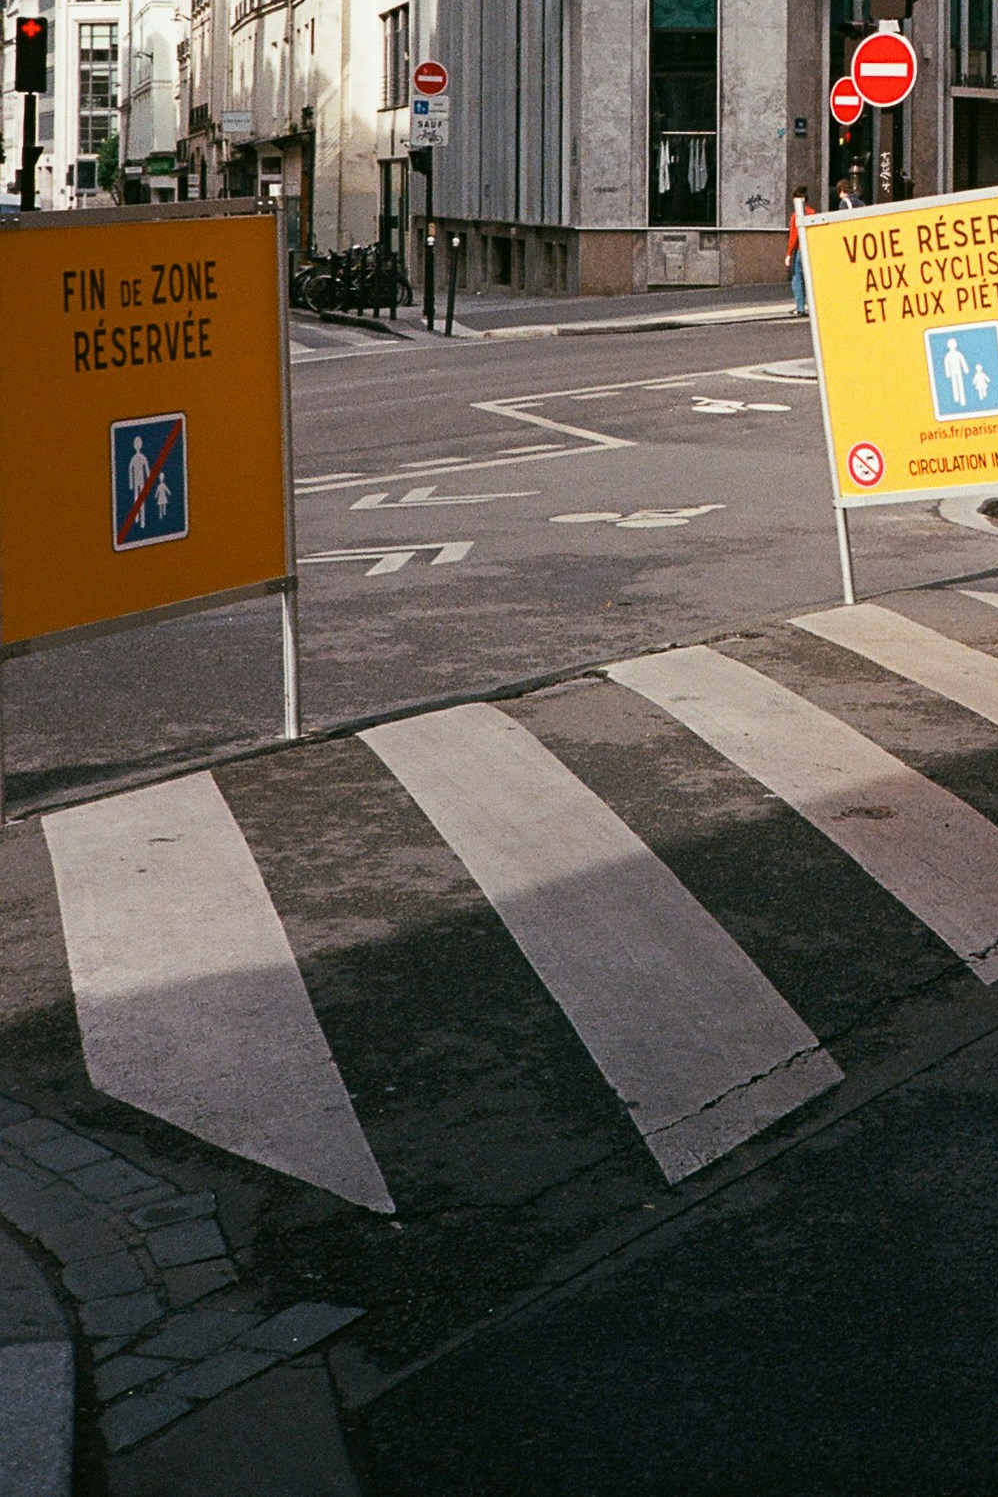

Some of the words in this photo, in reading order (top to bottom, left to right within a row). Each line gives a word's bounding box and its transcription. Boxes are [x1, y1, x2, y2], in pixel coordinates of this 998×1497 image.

[417, 120, 442, 128] SAUF
[843, 229, 904, 263] VOIE
[62, 267, 106, 313] FIN
[120, 278, 143, 307] DE
[151, 260, 218, 305] ZONE
[865, 265, 909, 293] AUX
[863, 298, 888, 324] ET
[902, 290, 945, 319] AUX
[74, 310, 212, 373] RÉSERVÉE
[909, 455, 987, 477] CIRCULATION
